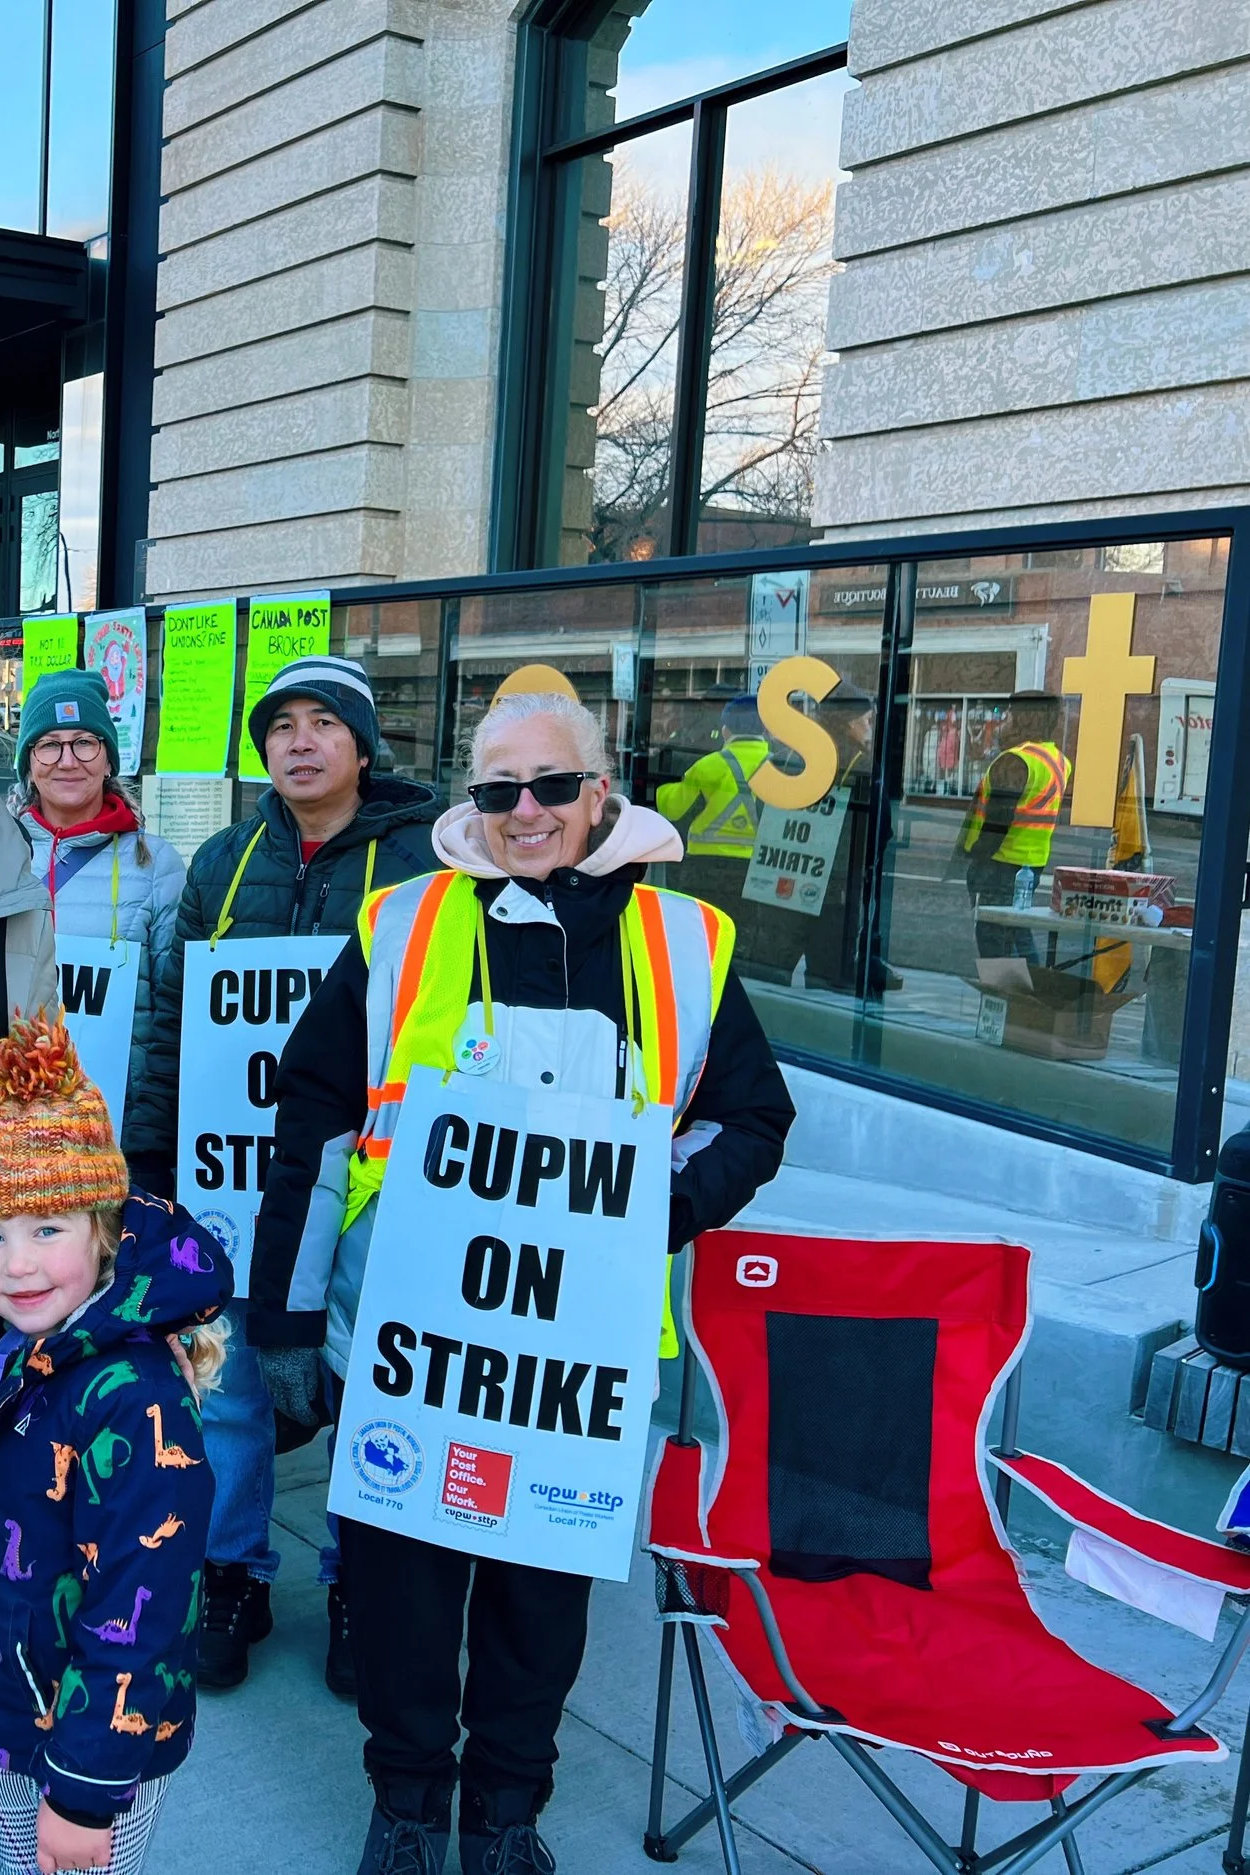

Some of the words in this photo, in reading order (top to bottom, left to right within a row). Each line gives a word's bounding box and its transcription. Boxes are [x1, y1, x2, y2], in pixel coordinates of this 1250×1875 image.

[168, 616, 195, 632] DONT
[196, 613, 219, 629] LIKE
[252, 609, 292, 629] CANADA
[298, 608, 328, 628] POST
[170, 631, 207, 648] UNIONS?
[208, 631, 227, 647] FINE
[268, 635, 315, 657] BROKE?
[423, 1113, 637, 1219] CUPW
[461, 1234, 565, 1322] ON
[372, 1321, 629, 1442] STRIKE
[452, 1446, 478, 1462] Your
[450, 1458, 477, 1473] Post
[449, 1470, 487, 1487] Office.
[447, 1482, 469, 1495] Our
[358, 1490, 384, 1505] Local
[385, 1498, 403, 1511] 770
[445, 1493, 478, 1509] Work.
[548, 1514, 577, 1526] Local
[579, 1518, 598, 1530] 770
